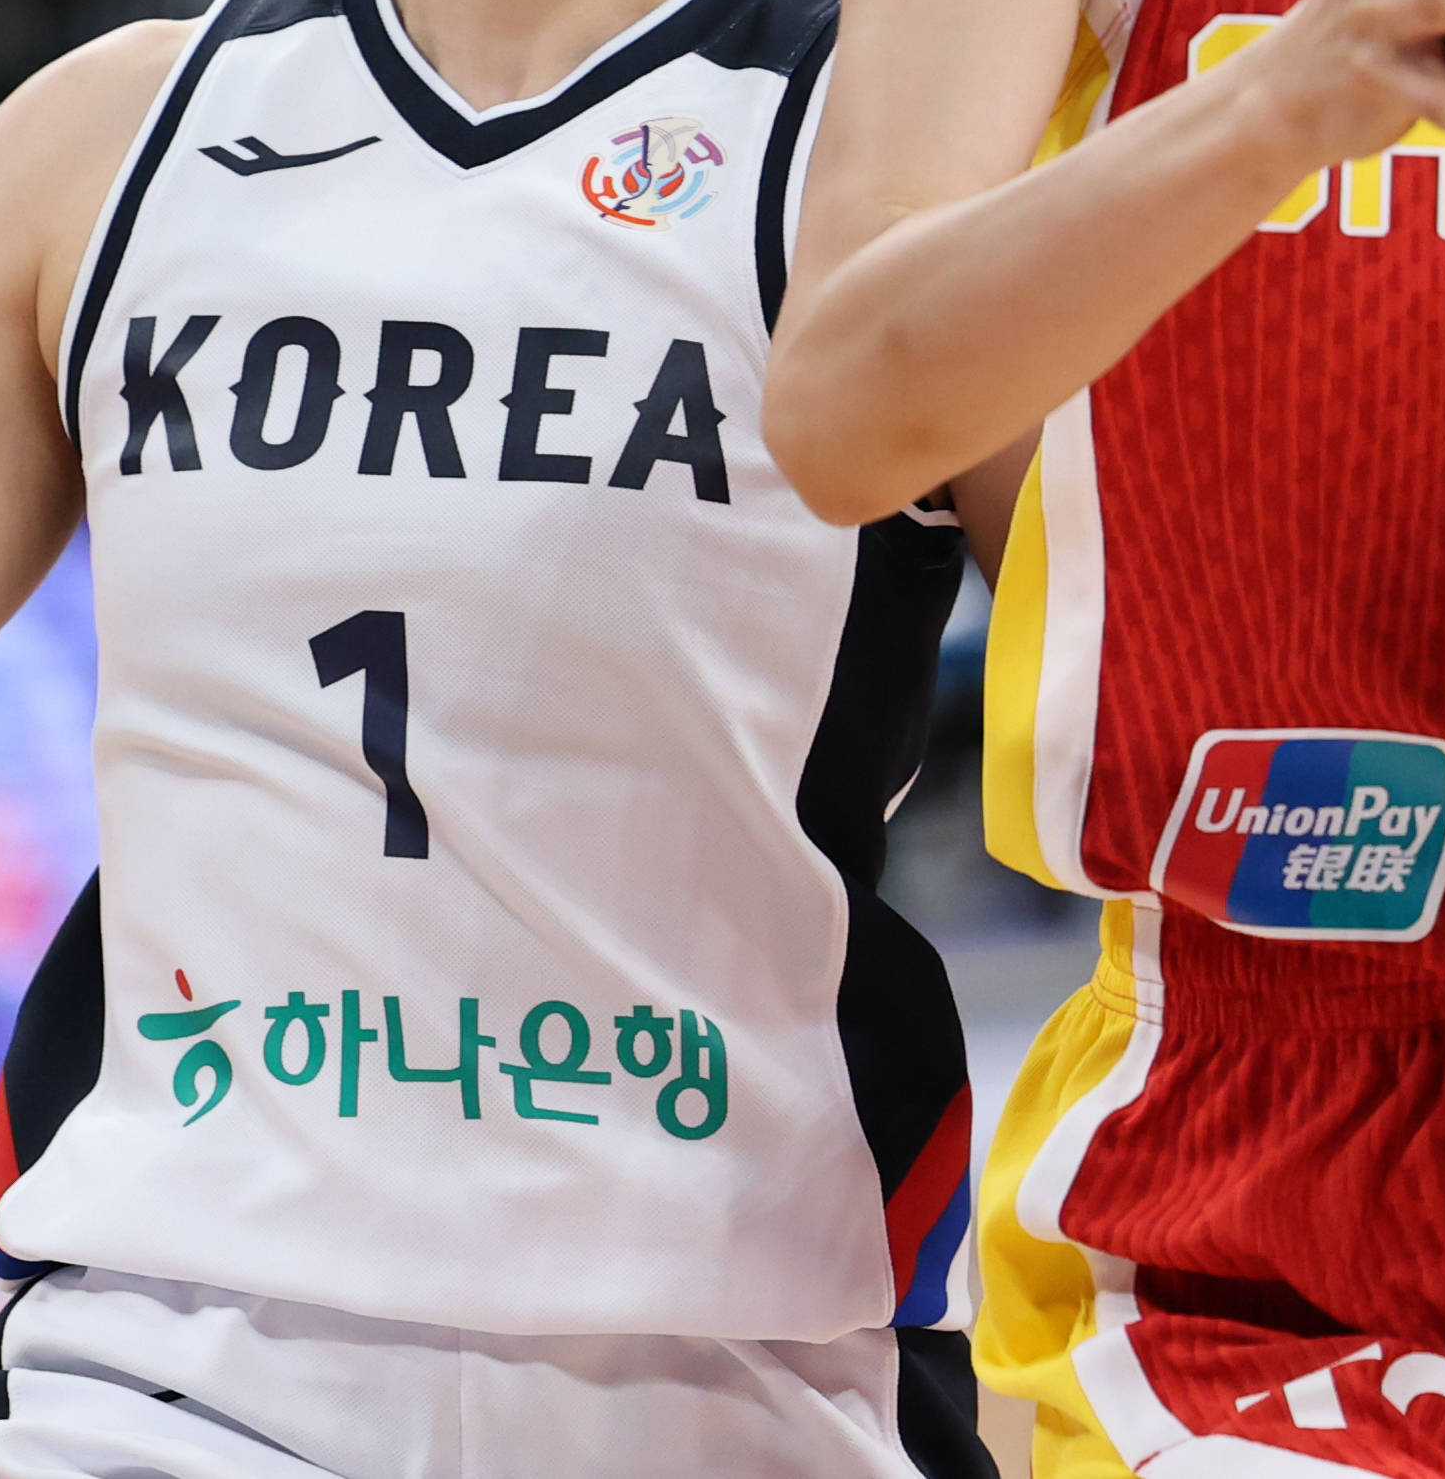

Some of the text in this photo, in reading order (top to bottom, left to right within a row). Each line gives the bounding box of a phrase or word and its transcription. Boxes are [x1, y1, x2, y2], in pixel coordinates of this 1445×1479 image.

[119, 315, 731, 505] KOREA
[308, 610, 429, 860] 1
[1195, 785, 1442, 859] UnionPay
[1282, 843, 1416, 893] 银联
[263, 989, 729, 1141] 하나은행
